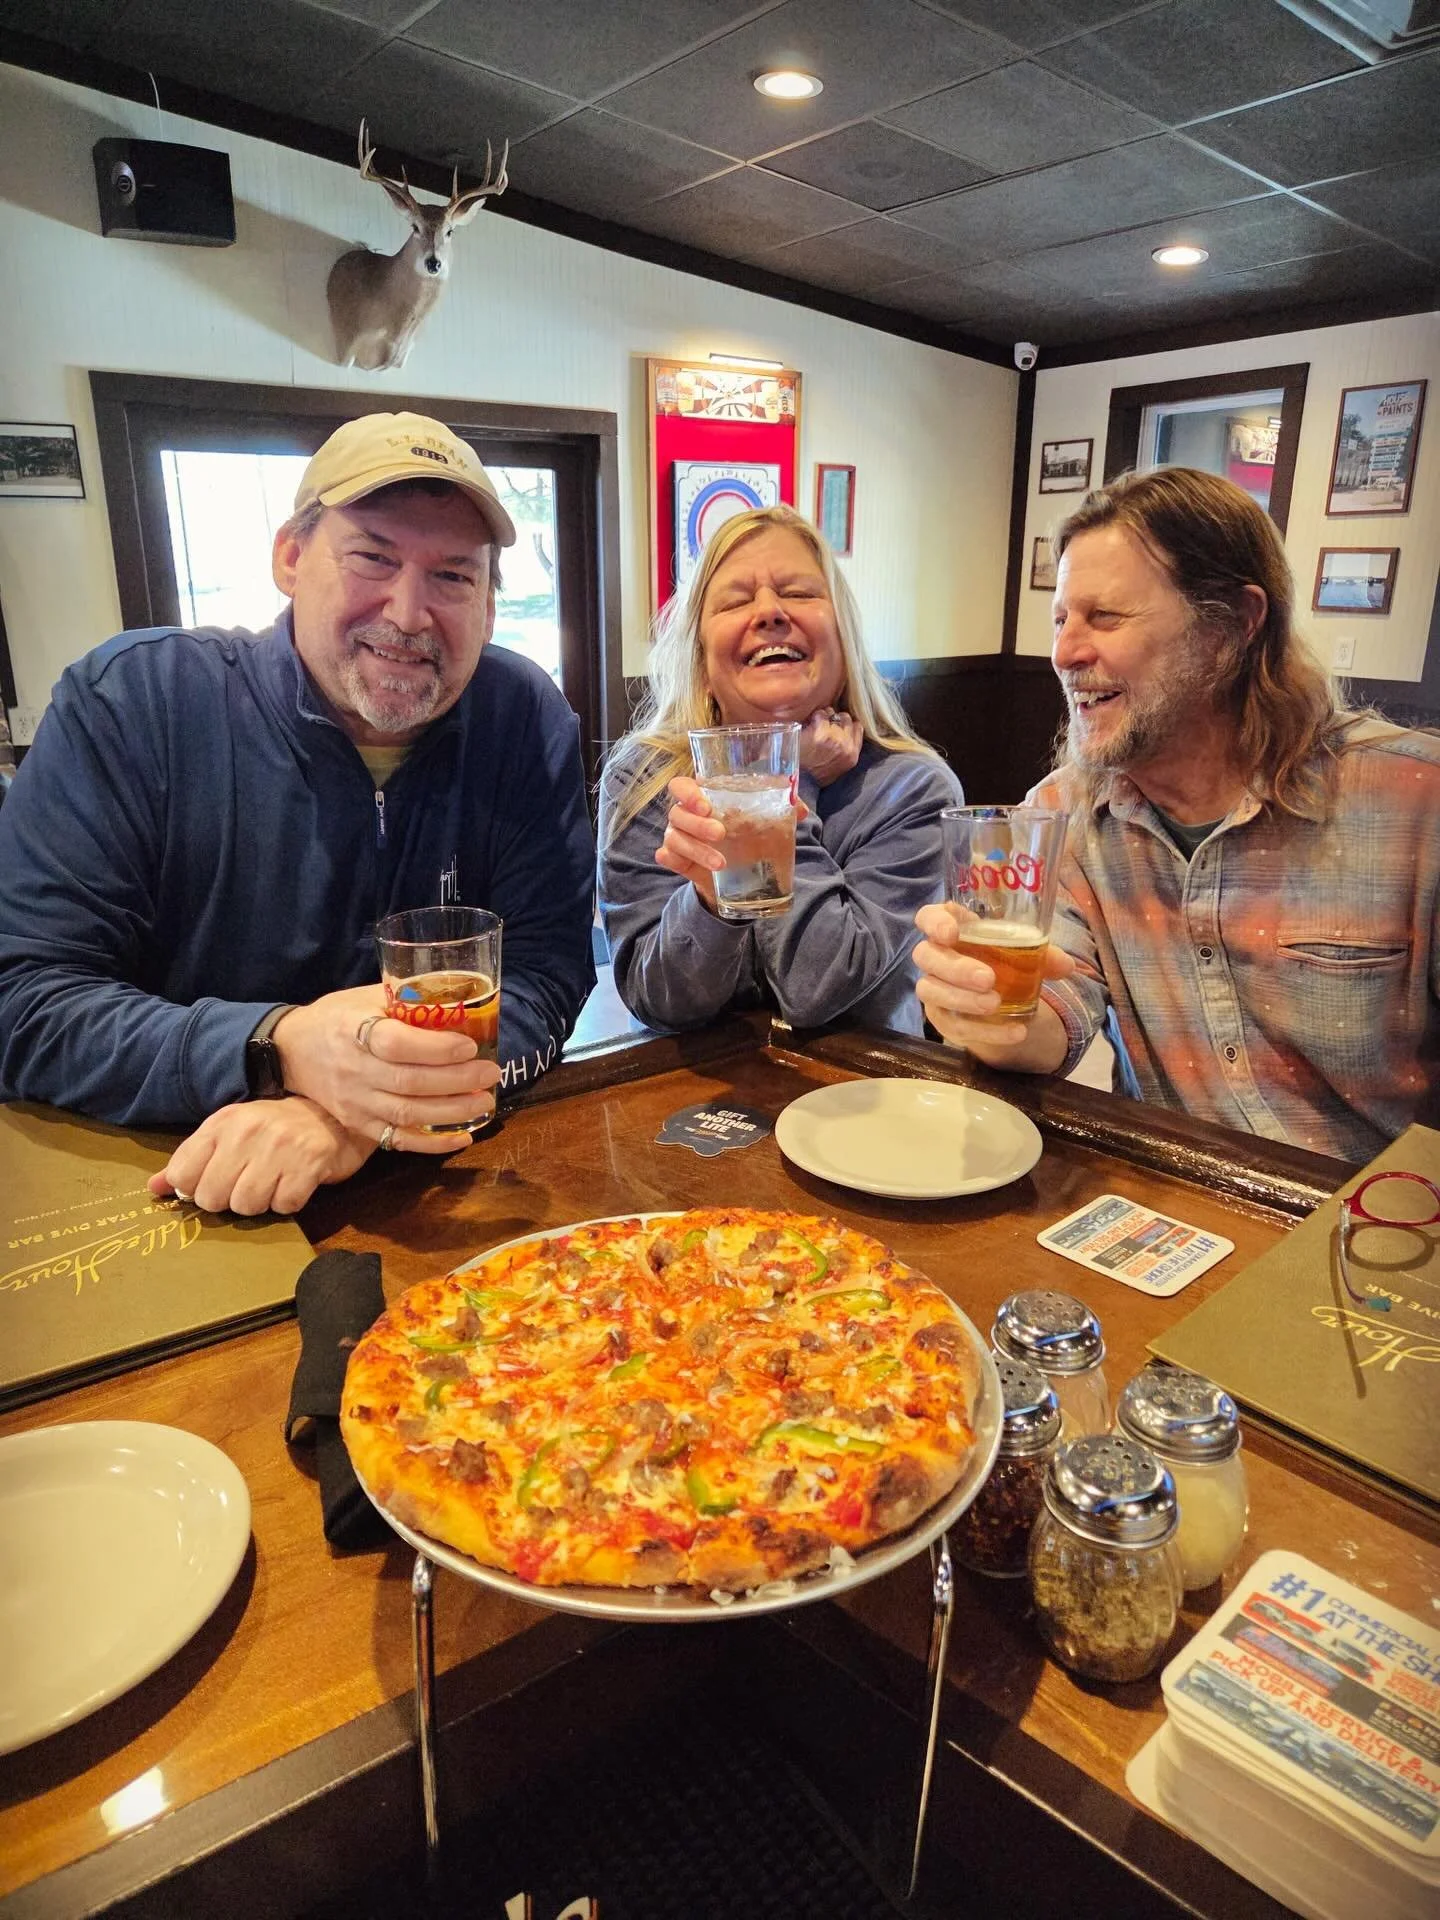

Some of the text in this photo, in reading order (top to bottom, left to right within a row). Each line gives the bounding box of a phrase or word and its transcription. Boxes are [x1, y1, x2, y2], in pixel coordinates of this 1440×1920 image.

[1382, 403, 1414, 417] PAINTS
[413, 446, 449, 465] 1912
[693, 1112, 757, 1131] ANOTHER
[717, 1110, 748, 1120] GIFT
[700, 1121, 731, 1133] LITE
[97, 1210, 139, 1227] STAR
[50, 1222, 91, 1239] DIVE
[8, 1233, 45, 1249] BAR
[1364, 1283, 1440, 1319] IVE BAR
[1269, 1572, 1429, 1657] #1 COMMERCIAL
[1317, 1611, 1352, 1629] AT
[1355, 1626, 1405, 1661] THE
[1211, 1650, 1253, 1680] PICK
[1258, 1678, 1287, 1698] UP
[1288, 1699, 1333, 1729] AND
[1337, 1728, 1440, 1794] DELIVERY
[1239, 1655, 1313, 1705] MOBILE
[1317, 1702, 1404, 1758] SERVICE
[1406, 1755, 1423, 1771] &
